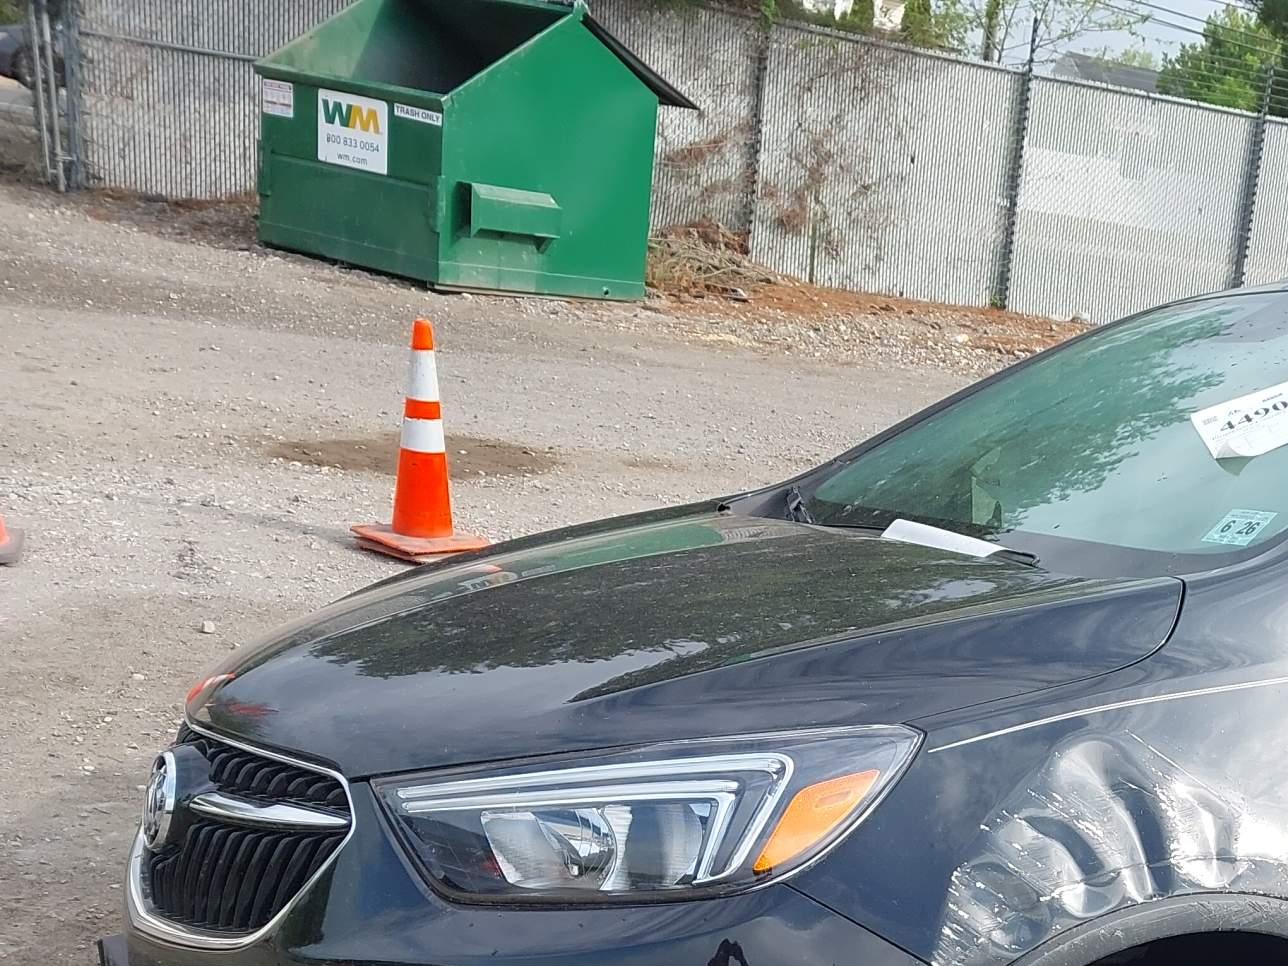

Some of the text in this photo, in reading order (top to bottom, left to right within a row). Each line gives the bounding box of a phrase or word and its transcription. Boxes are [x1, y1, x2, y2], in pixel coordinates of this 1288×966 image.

[322, 98, 381, 135] WM
[395, 105, 440, 123] TRASH ONLY
[325, 132, 380, 153] 800 833 0054
[336, 151, 368, 166] wm.com
[1220, 520, 1261, 535] 6 26
